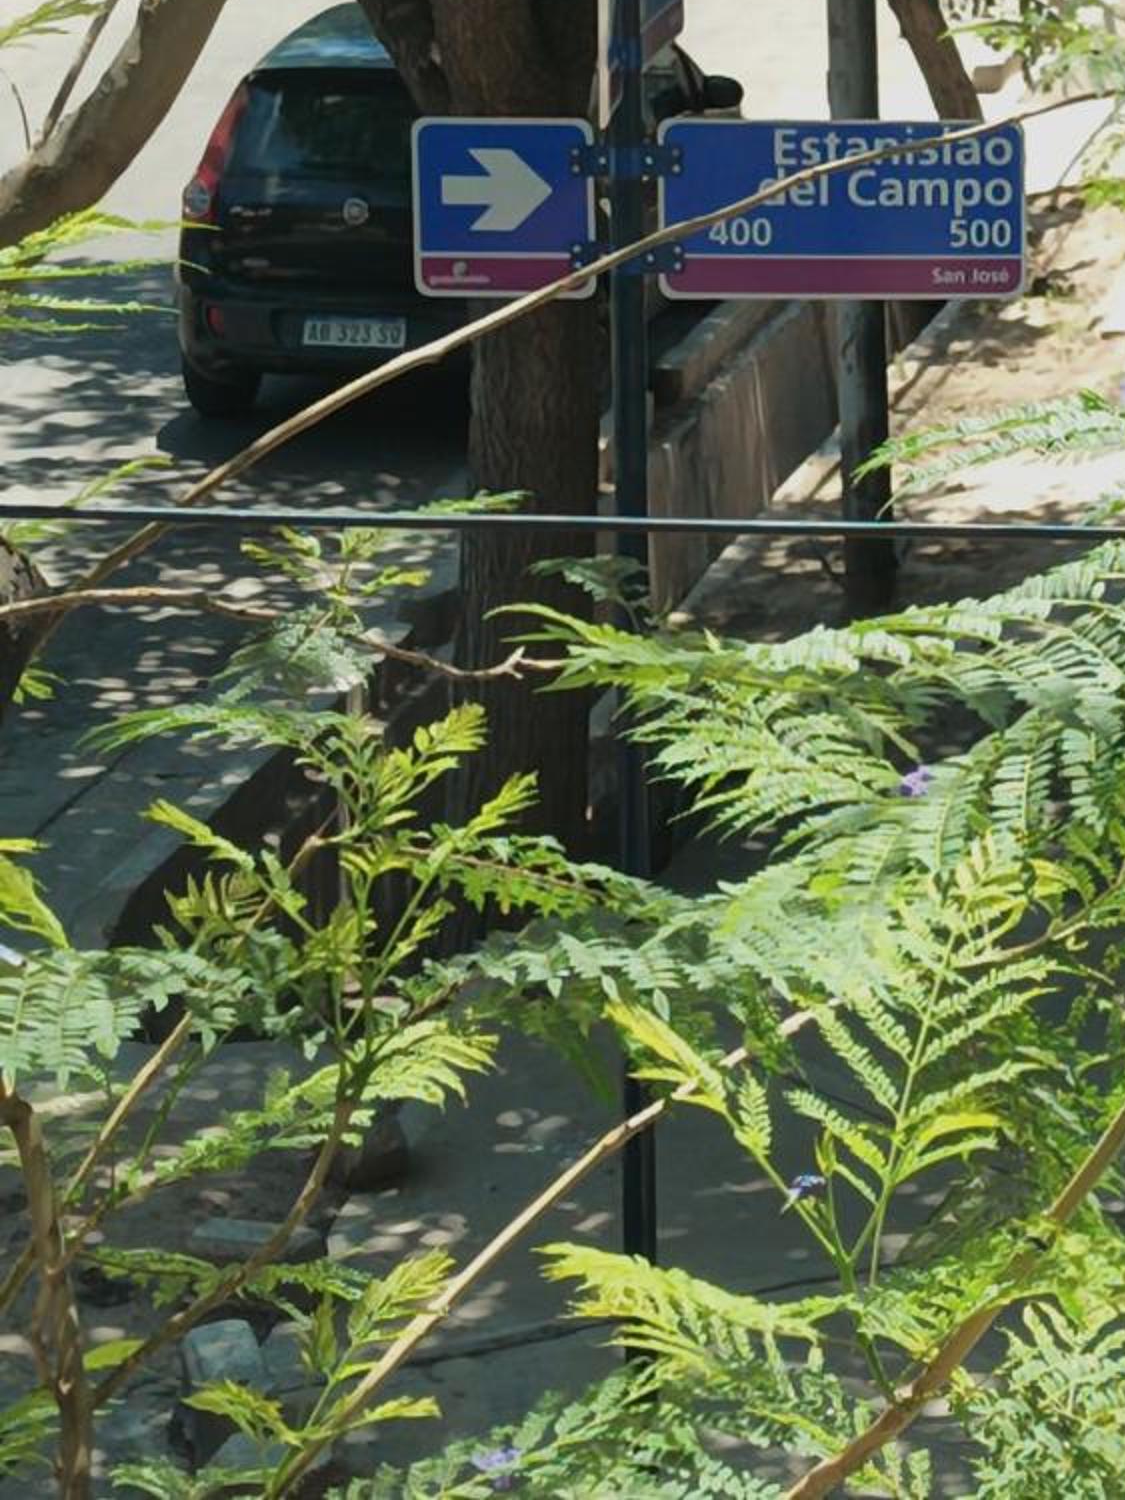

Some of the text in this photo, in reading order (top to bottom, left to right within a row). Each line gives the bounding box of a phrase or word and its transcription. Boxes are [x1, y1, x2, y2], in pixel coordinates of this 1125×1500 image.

[774, 128, 1013, 166] Estanislao
[758, 168, 1013, 217] del Campo
[708, 217, 772, 246] 400
[949, 219, 1012, 248] 500
[931, 265, 1010, 284] San José
